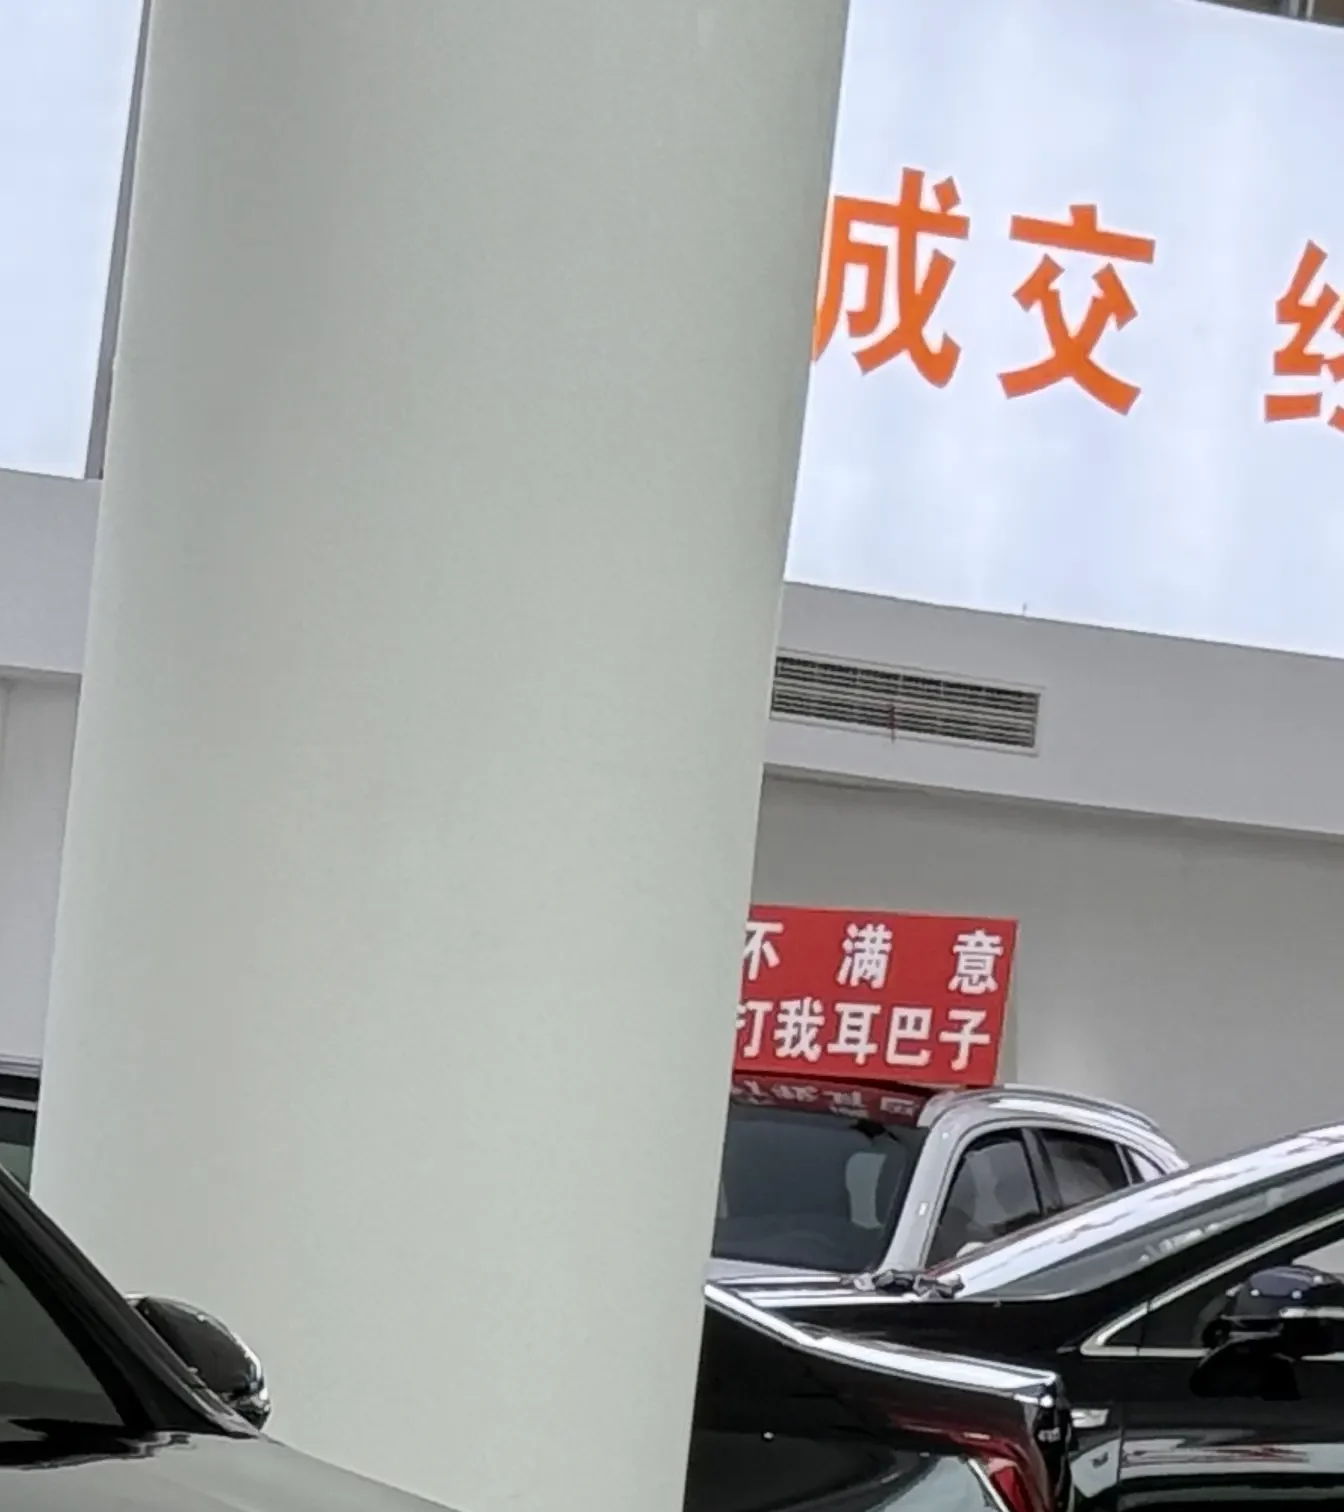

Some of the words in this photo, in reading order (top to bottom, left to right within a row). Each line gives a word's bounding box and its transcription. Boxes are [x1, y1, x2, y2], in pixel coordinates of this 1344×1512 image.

[812, 166, 1156, 416] 成交
[742, 921, 1005, 995] 不满意
[735, 996, 992, 1071] 打我耳巴子
